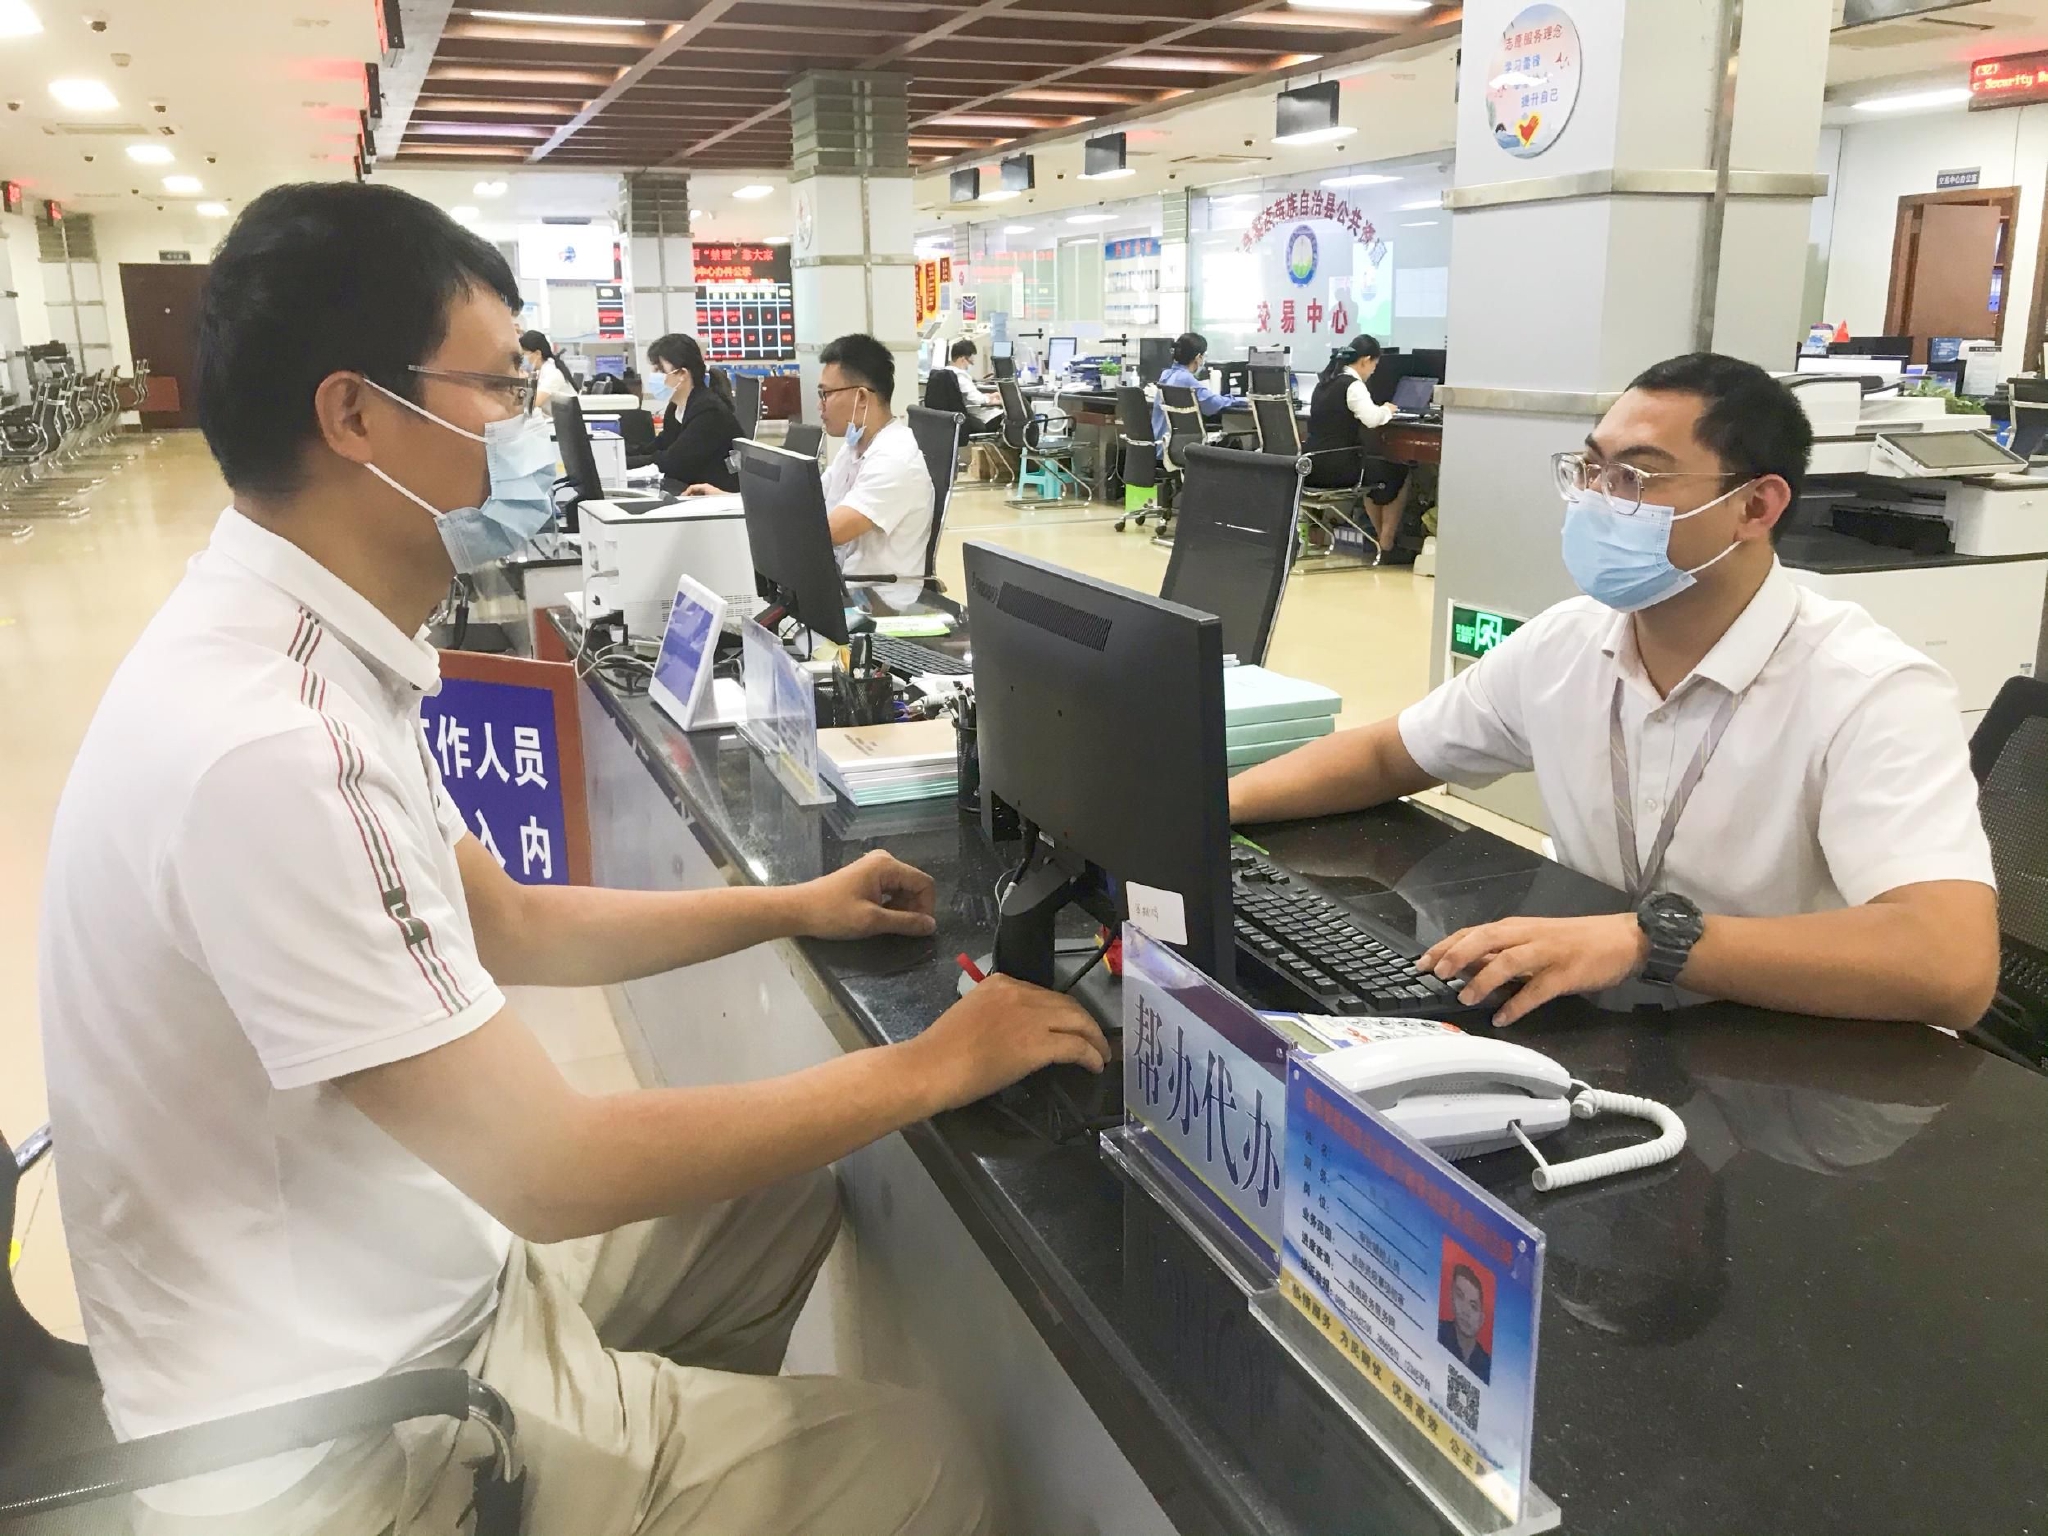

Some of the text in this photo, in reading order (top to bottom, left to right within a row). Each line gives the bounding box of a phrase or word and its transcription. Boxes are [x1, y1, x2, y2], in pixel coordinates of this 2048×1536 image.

[1504, 24, 1563, 51] 志愿服务理念
[1504, 54, 1541, 72] 学习雷锋
[1985, 73, 2033, 90] Security
[1521, 88, 1559, 108] 提升自己
[1257, 298, 1348, 334] 交易中心
[1133, 993, 1281, 1209] 帮办代办
